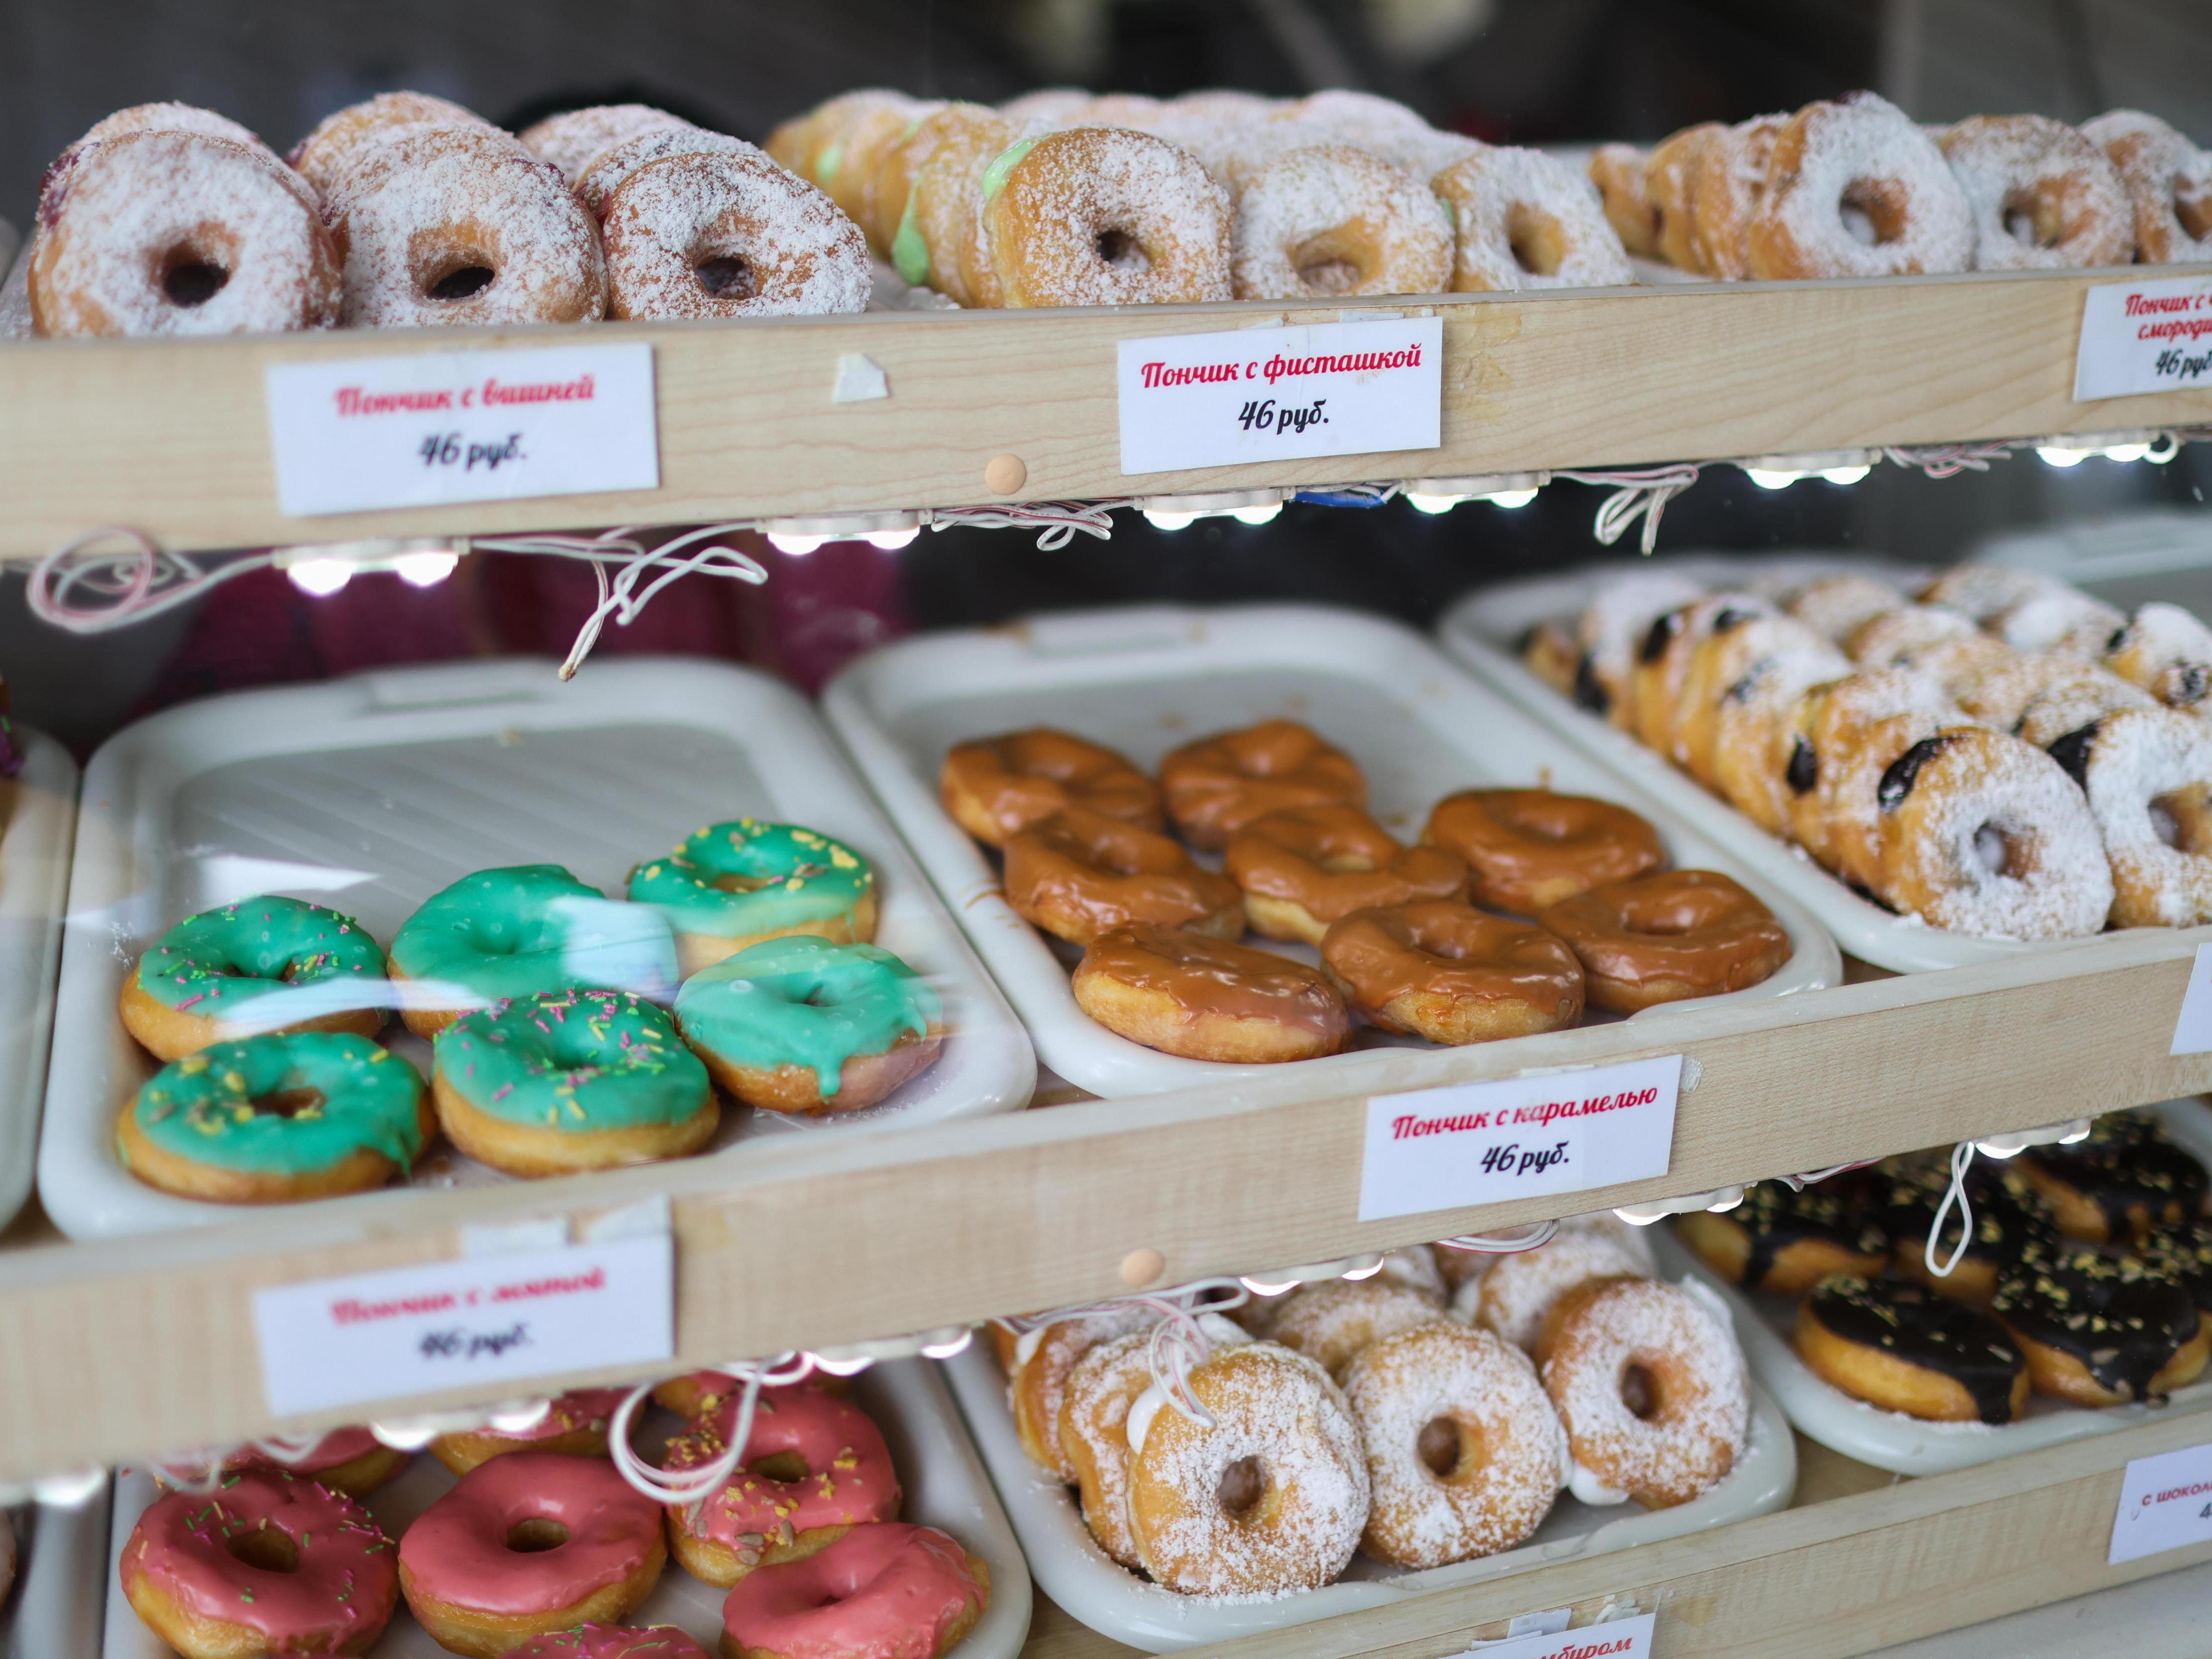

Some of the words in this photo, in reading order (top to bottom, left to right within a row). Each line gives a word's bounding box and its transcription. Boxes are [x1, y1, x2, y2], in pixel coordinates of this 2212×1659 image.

[2125, 293, 2192, 317] Пончик
[2195, 294, 2205, 311] с
[1140, 361, 1239, 389] Пончик
[1245, 361, 1258, 380] с
[1263, 343, 1422, 385] фисташкой
[2155, 348, 2183, 376] 46
[334, 385, 452, 417] Пончик
[460, 387, 474, 409] с
[481, 374, 595, 407] вишней
[1238, 399, 1276, 431] 46
[1276, 399, 1329, 435] руб.
[418, 432, 462, 467] 46
[465, 433, 528, 471] руб.
[1391, 1110, 1490, 1140] Пончик
[1494, 1108, 1509, 1127] с
[1512, 1087, 1658, 1128] карамелью
[1480, 1143, 1518, 1174] 46
[1516, 1141, 1570, 1176] руб.
[2142, 1494, 2152, 1506] с
[2156, 1481, 2212, 1504] шокол
